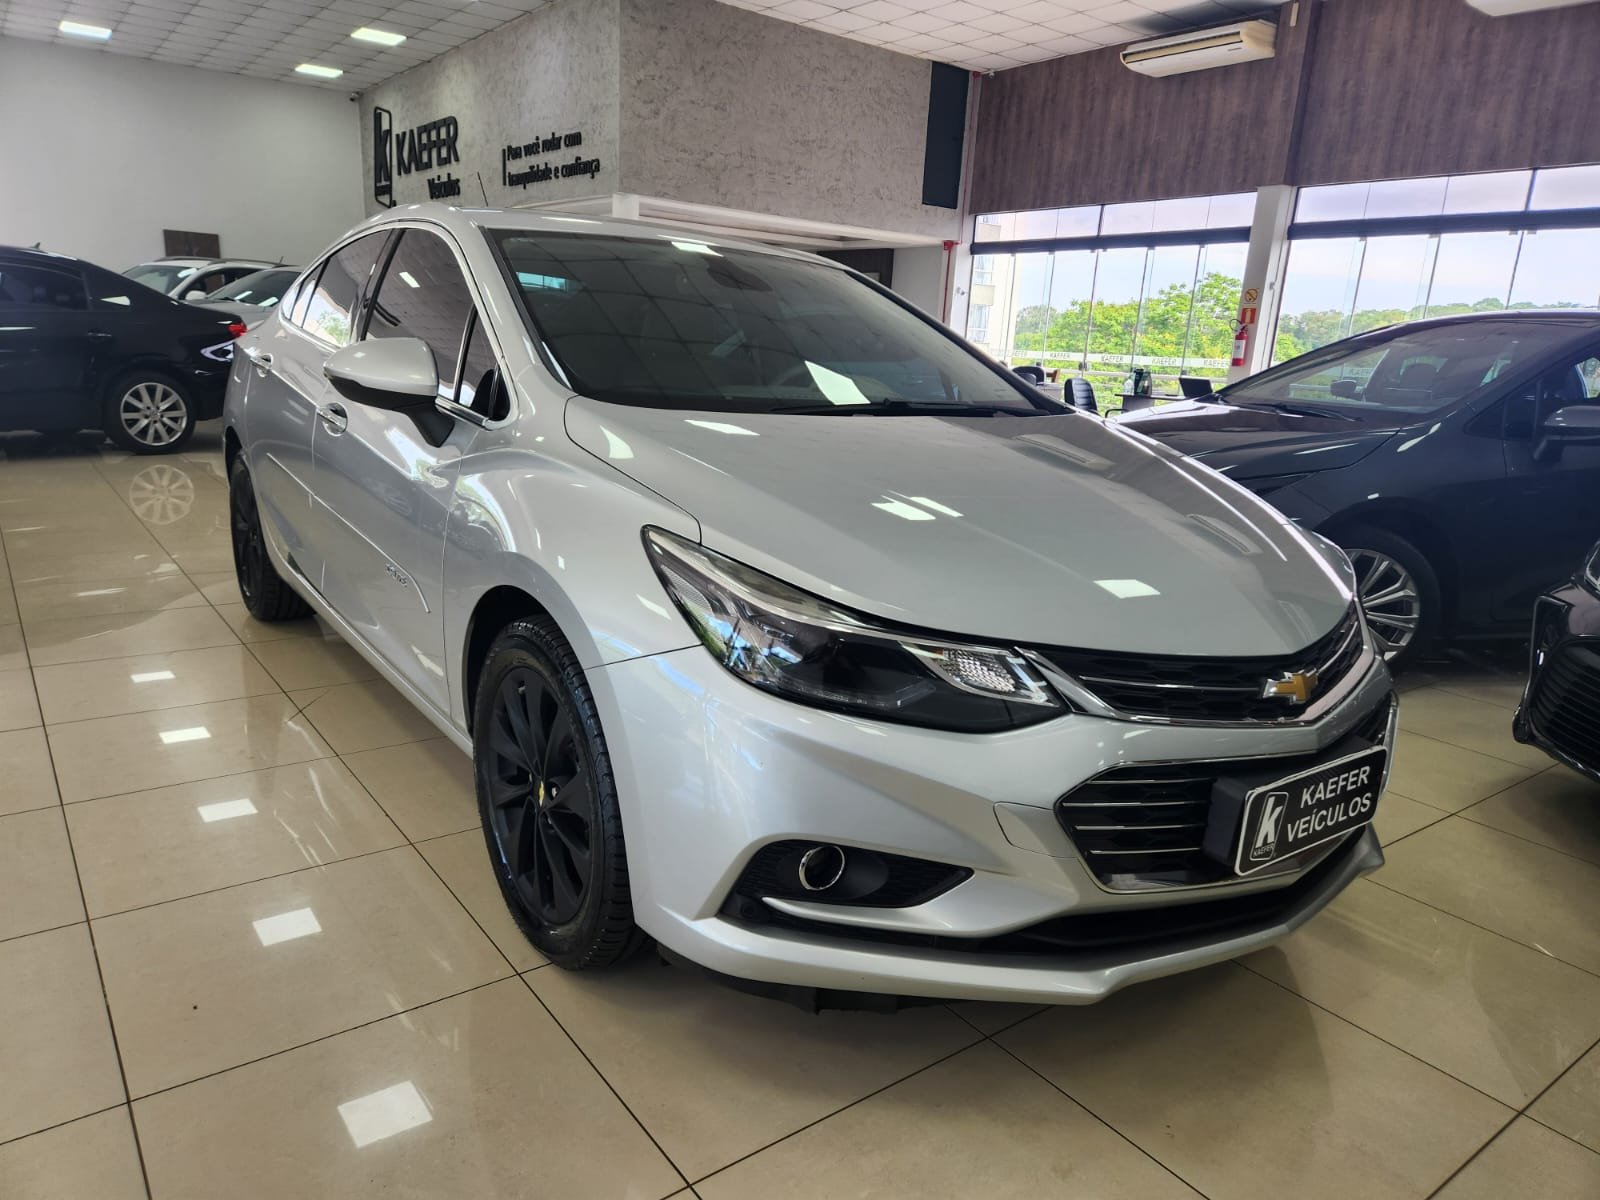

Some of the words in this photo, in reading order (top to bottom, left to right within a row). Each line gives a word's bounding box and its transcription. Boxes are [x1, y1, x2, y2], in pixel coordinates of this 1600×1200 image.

[395, 116, 460, 176] KAEFER
[563, 132, 582, 148] com
[553, 166, 560, 179] e
[1300, 765, 1371, 809] KAEFER
[1286, 792, 1372, 843] VEÍCULOS
